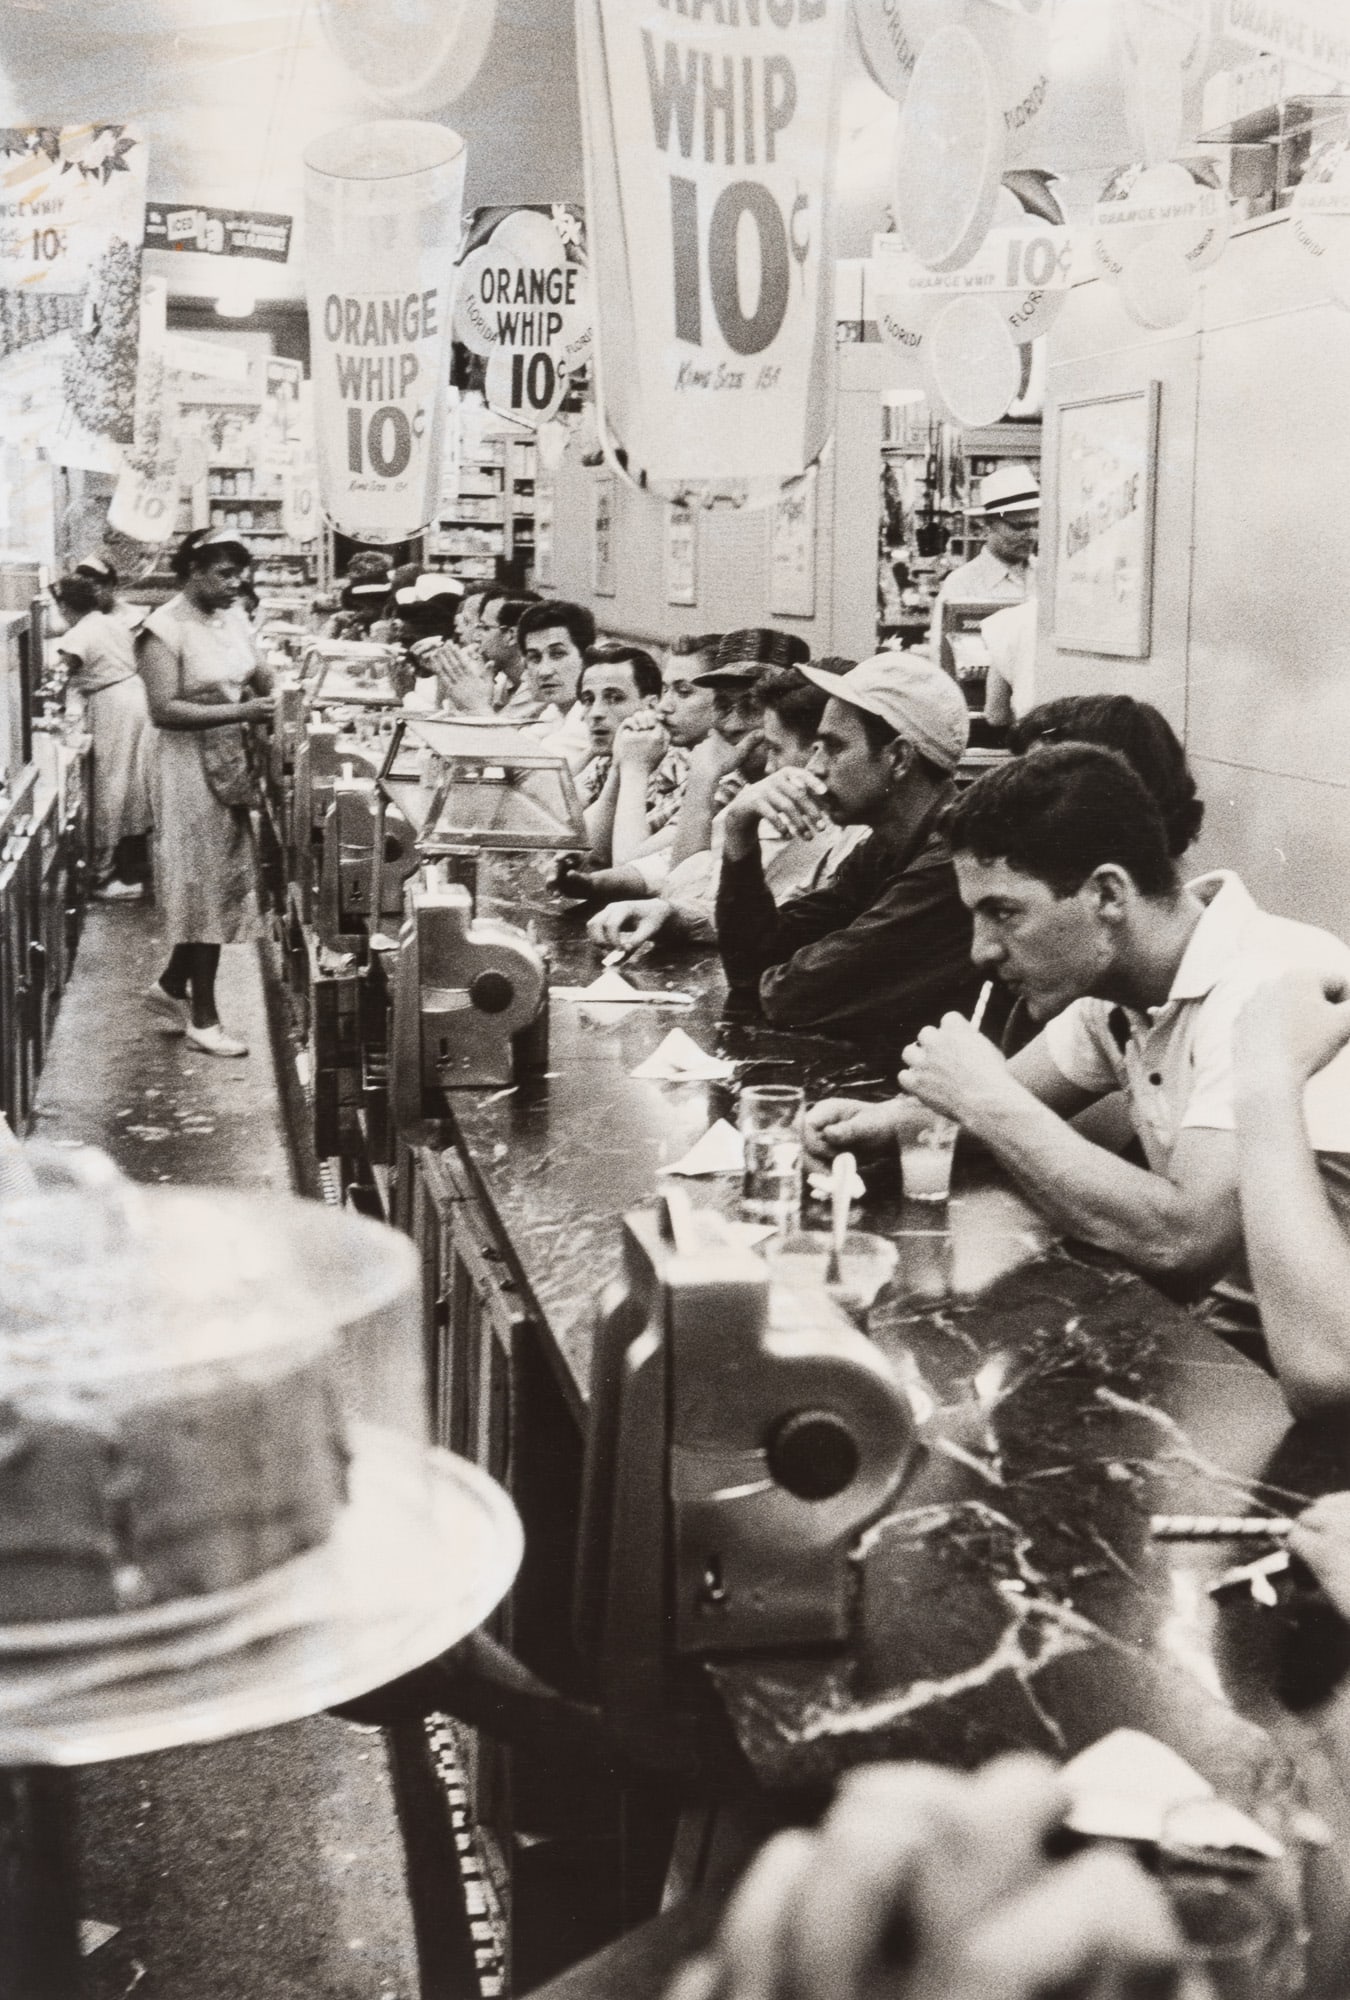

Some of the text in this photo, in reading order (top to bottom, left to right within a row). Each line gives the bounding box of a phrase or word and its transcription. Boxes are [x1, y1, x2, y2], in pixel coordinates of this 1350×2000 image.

[641, 26, 797, 165] WHIP
[907, 275, 960, 289] ORANGE
[1006, 236, 1073, 287] 10¢
[480, 267, 577, 306] ORANGE
[1008, 289, 1044, 328] FLOR
[324, 289, 438, 346] ORANGE
[465, 294, 500, 342] FLORIDA
[496, 310, 564, 346] WHIP
[336, 352, 419, 401] WHIP
